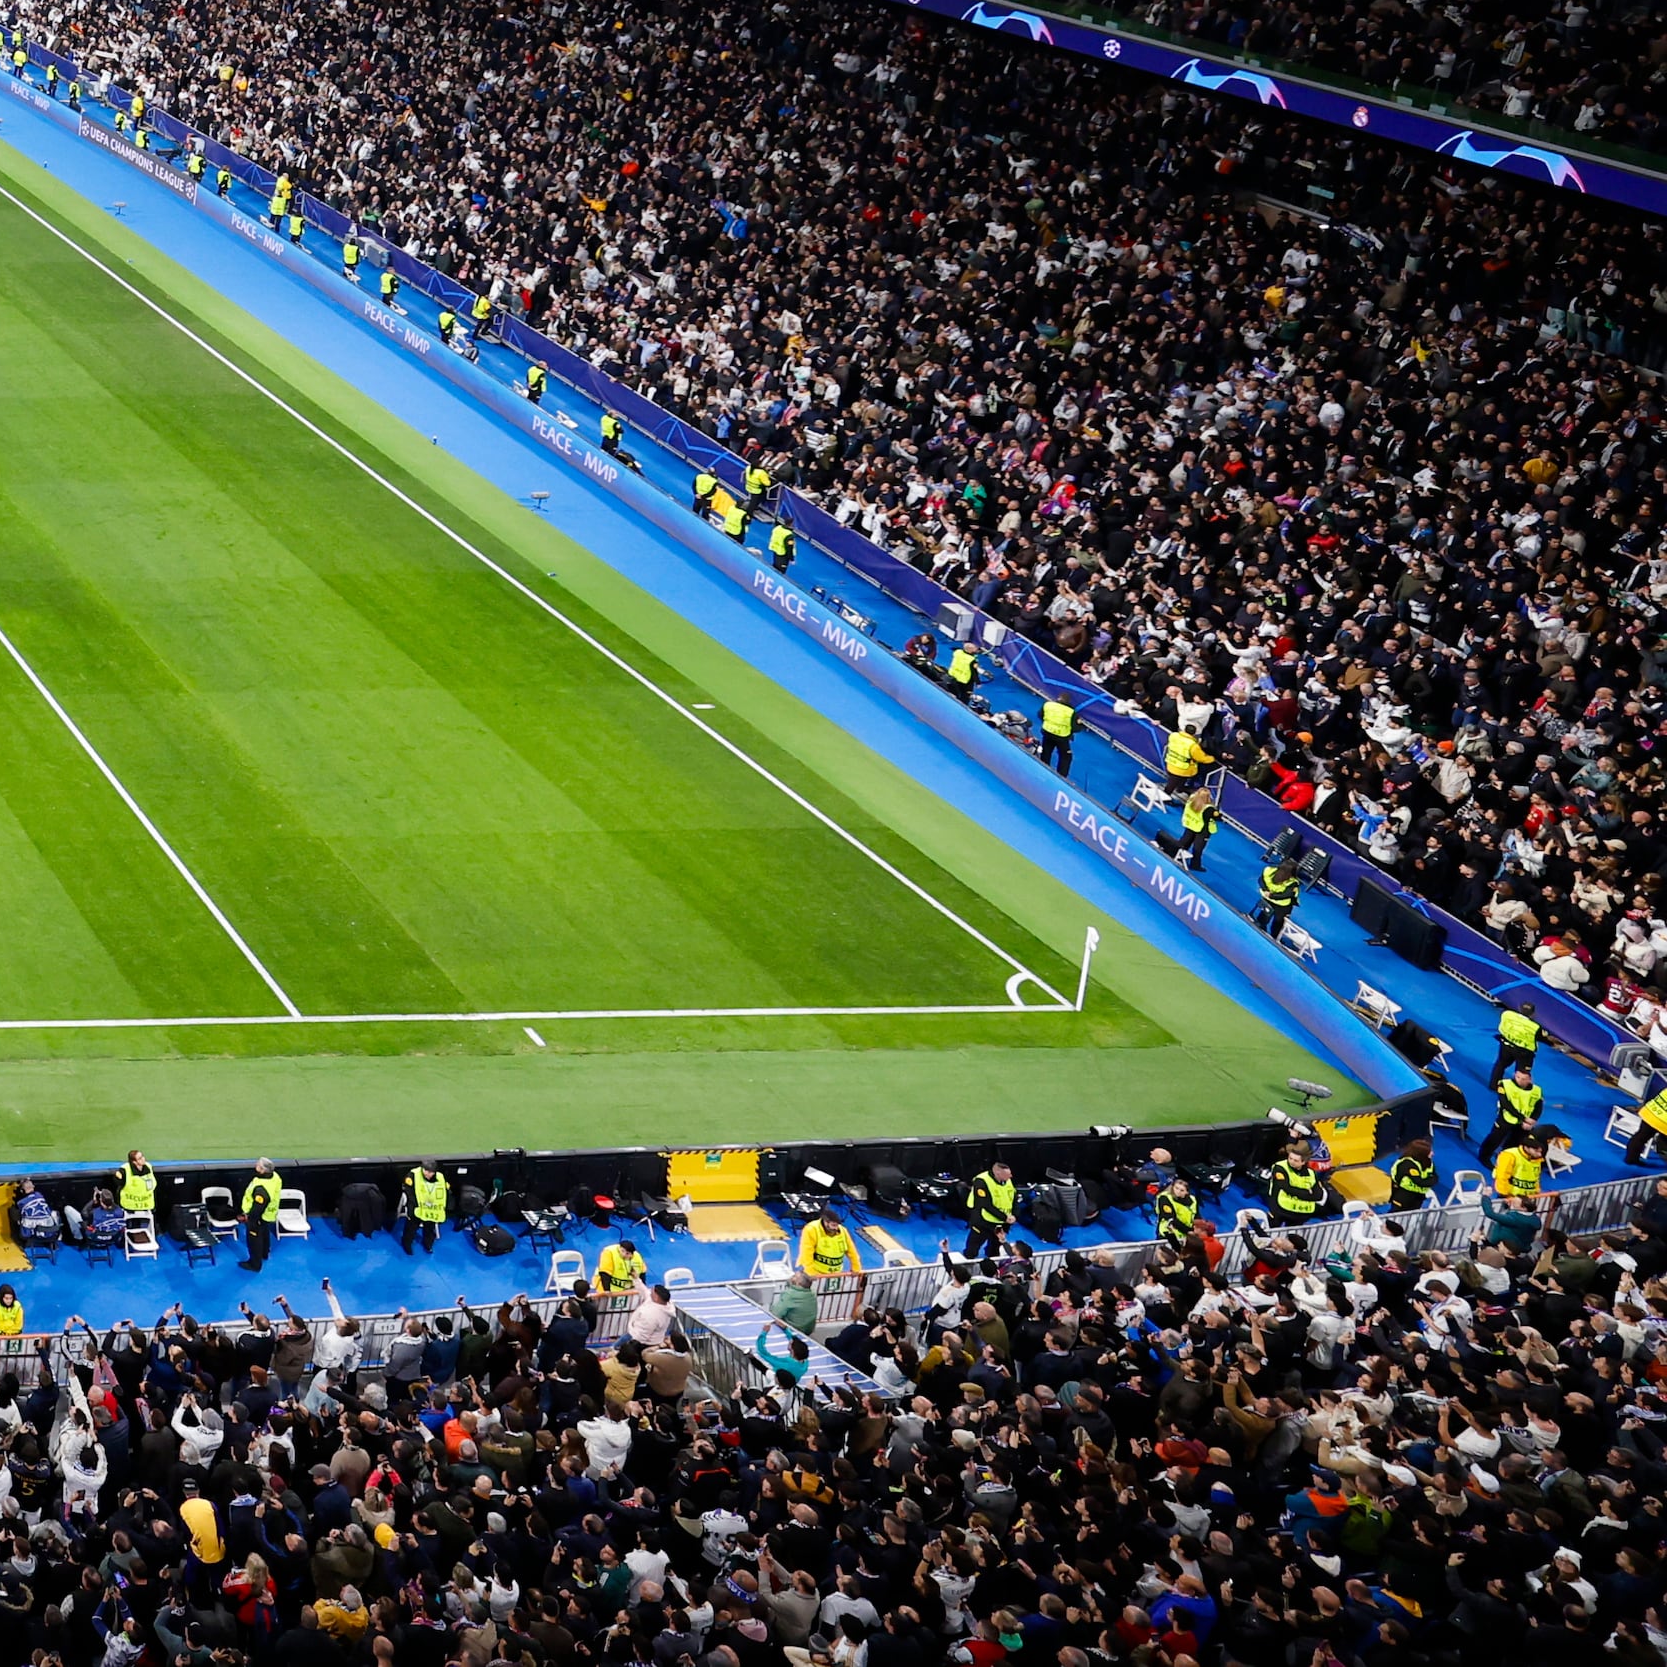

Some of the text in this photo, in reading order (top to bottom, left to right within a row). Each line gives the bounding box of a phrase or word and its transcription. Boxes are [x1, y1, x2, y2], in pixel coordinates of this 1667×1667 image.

[11, 81, 29, 100] PEACE
[90, 126, 185, 192] UEFA CHAMPIONS LEAGUE
[231, 212, 257, 240] PEACE
[365, 302, 395, 334] PEACE
[532, 415, 573, 456] PEACE
[754, 570, 807, 622] PEACE
[1054, 790, 1129, 863] PEACE
[21, 1482, 36, 1496] 5
